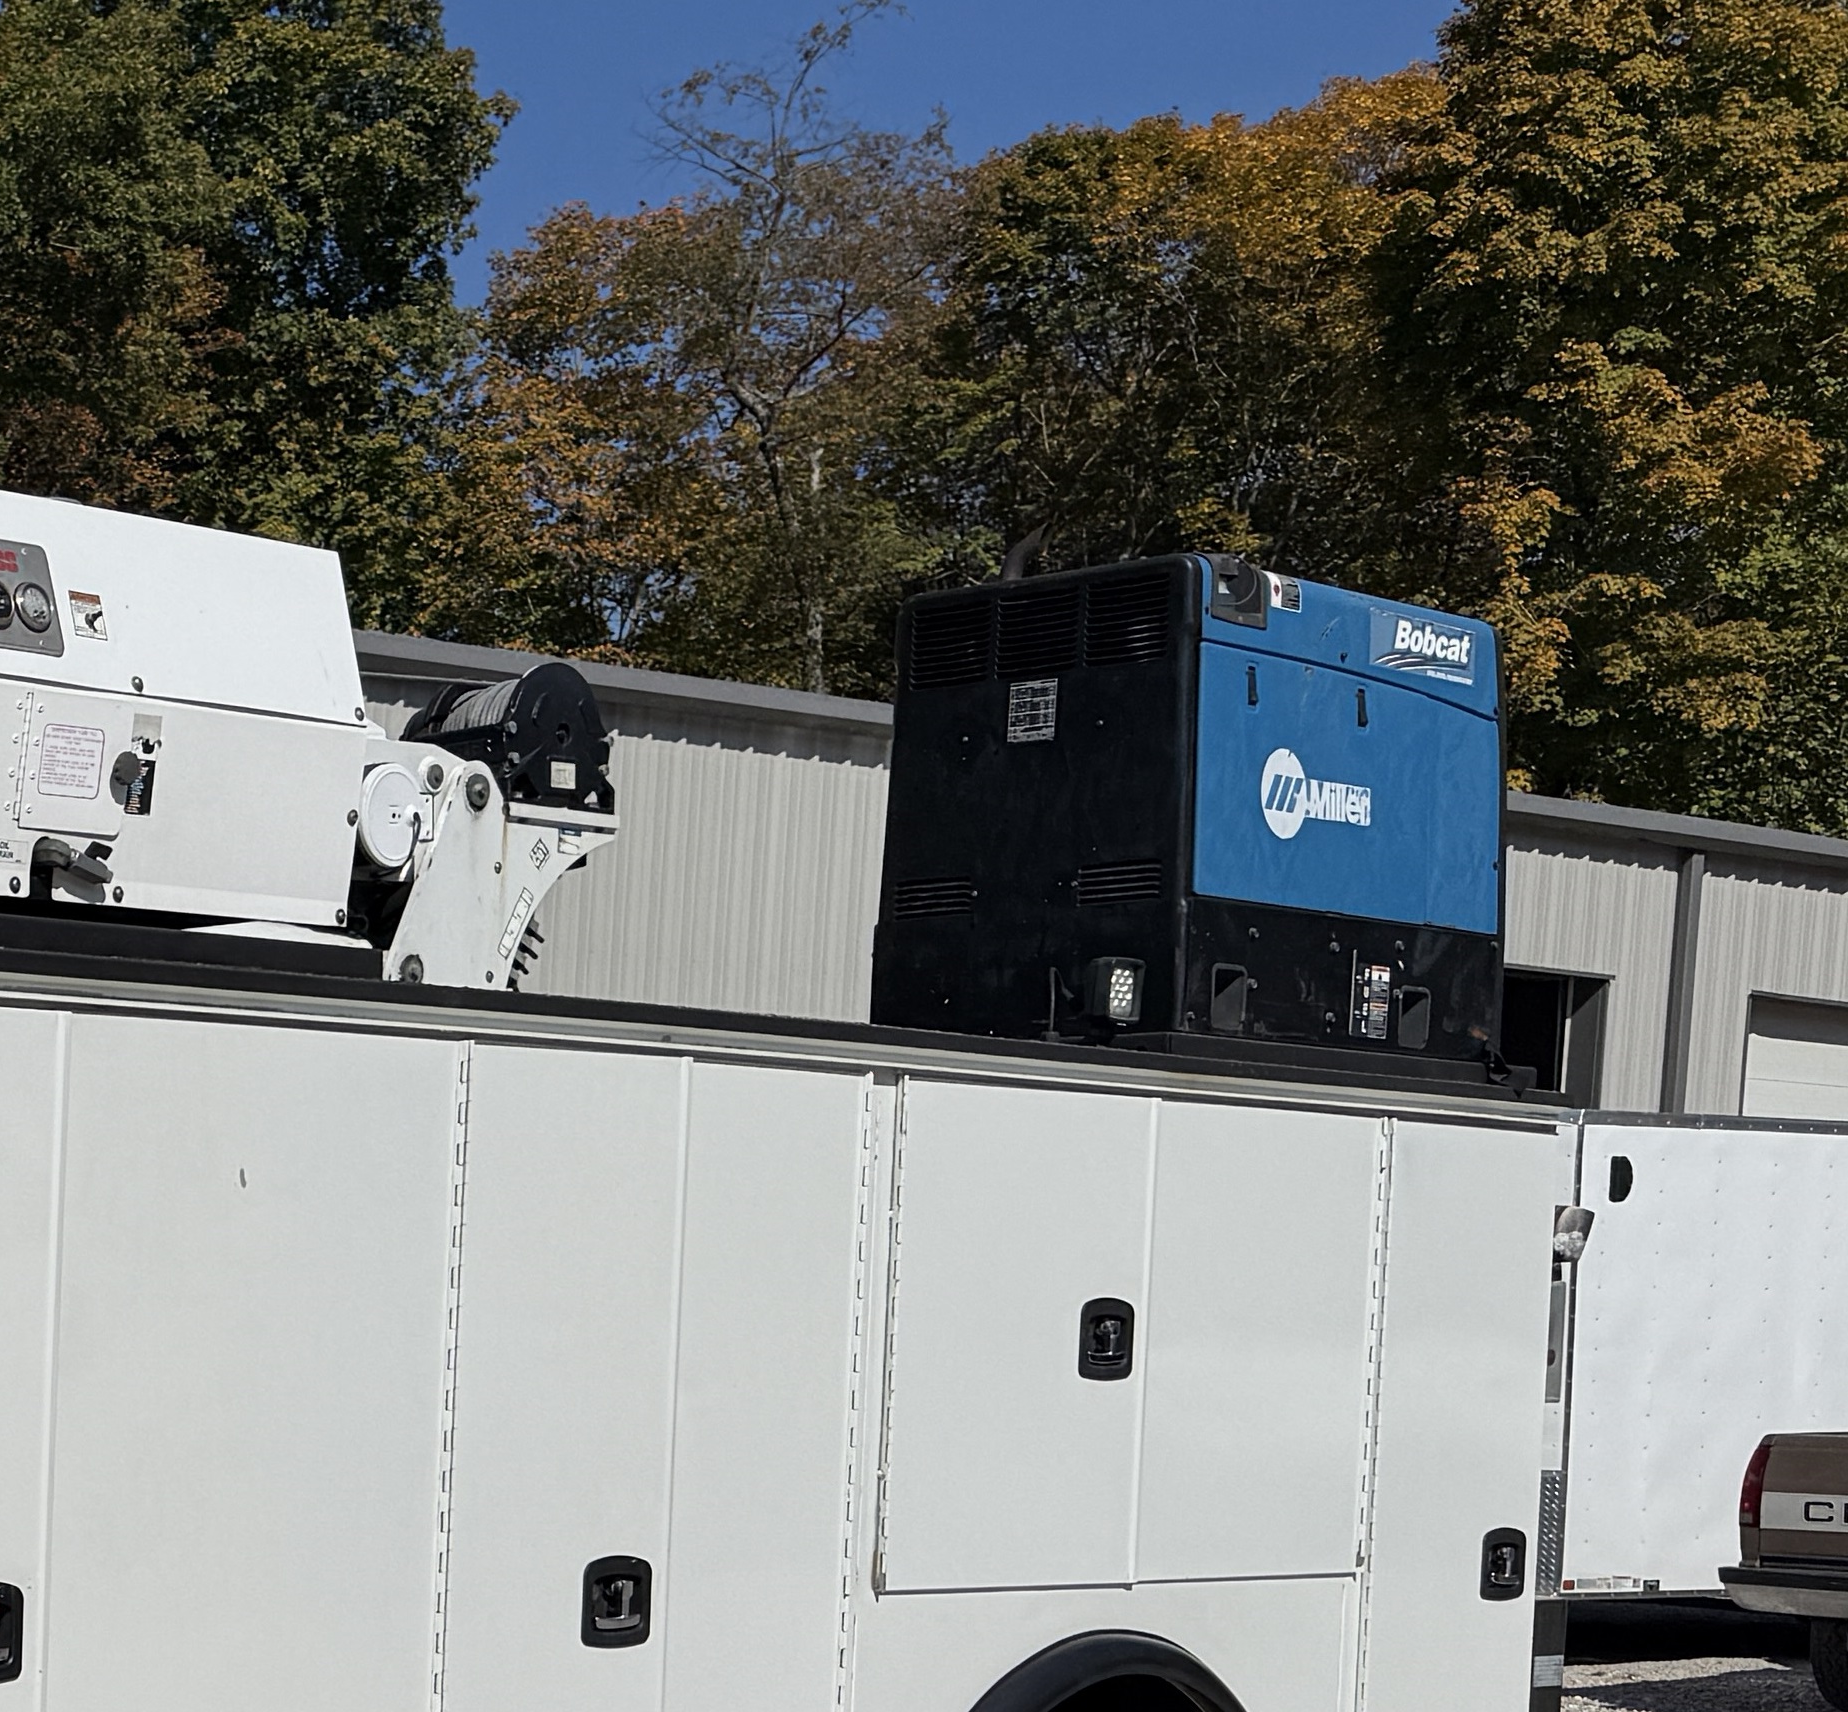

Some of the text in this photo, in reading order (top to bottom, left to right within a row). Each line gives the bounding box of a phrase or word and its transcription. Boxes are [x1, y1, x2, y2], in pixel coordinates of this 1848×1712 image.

[1394, 619, 1471, 664] Bobcat
[1304, 779, 1371, 827] Miller
[1804, 1502, 1848, 1523] C
